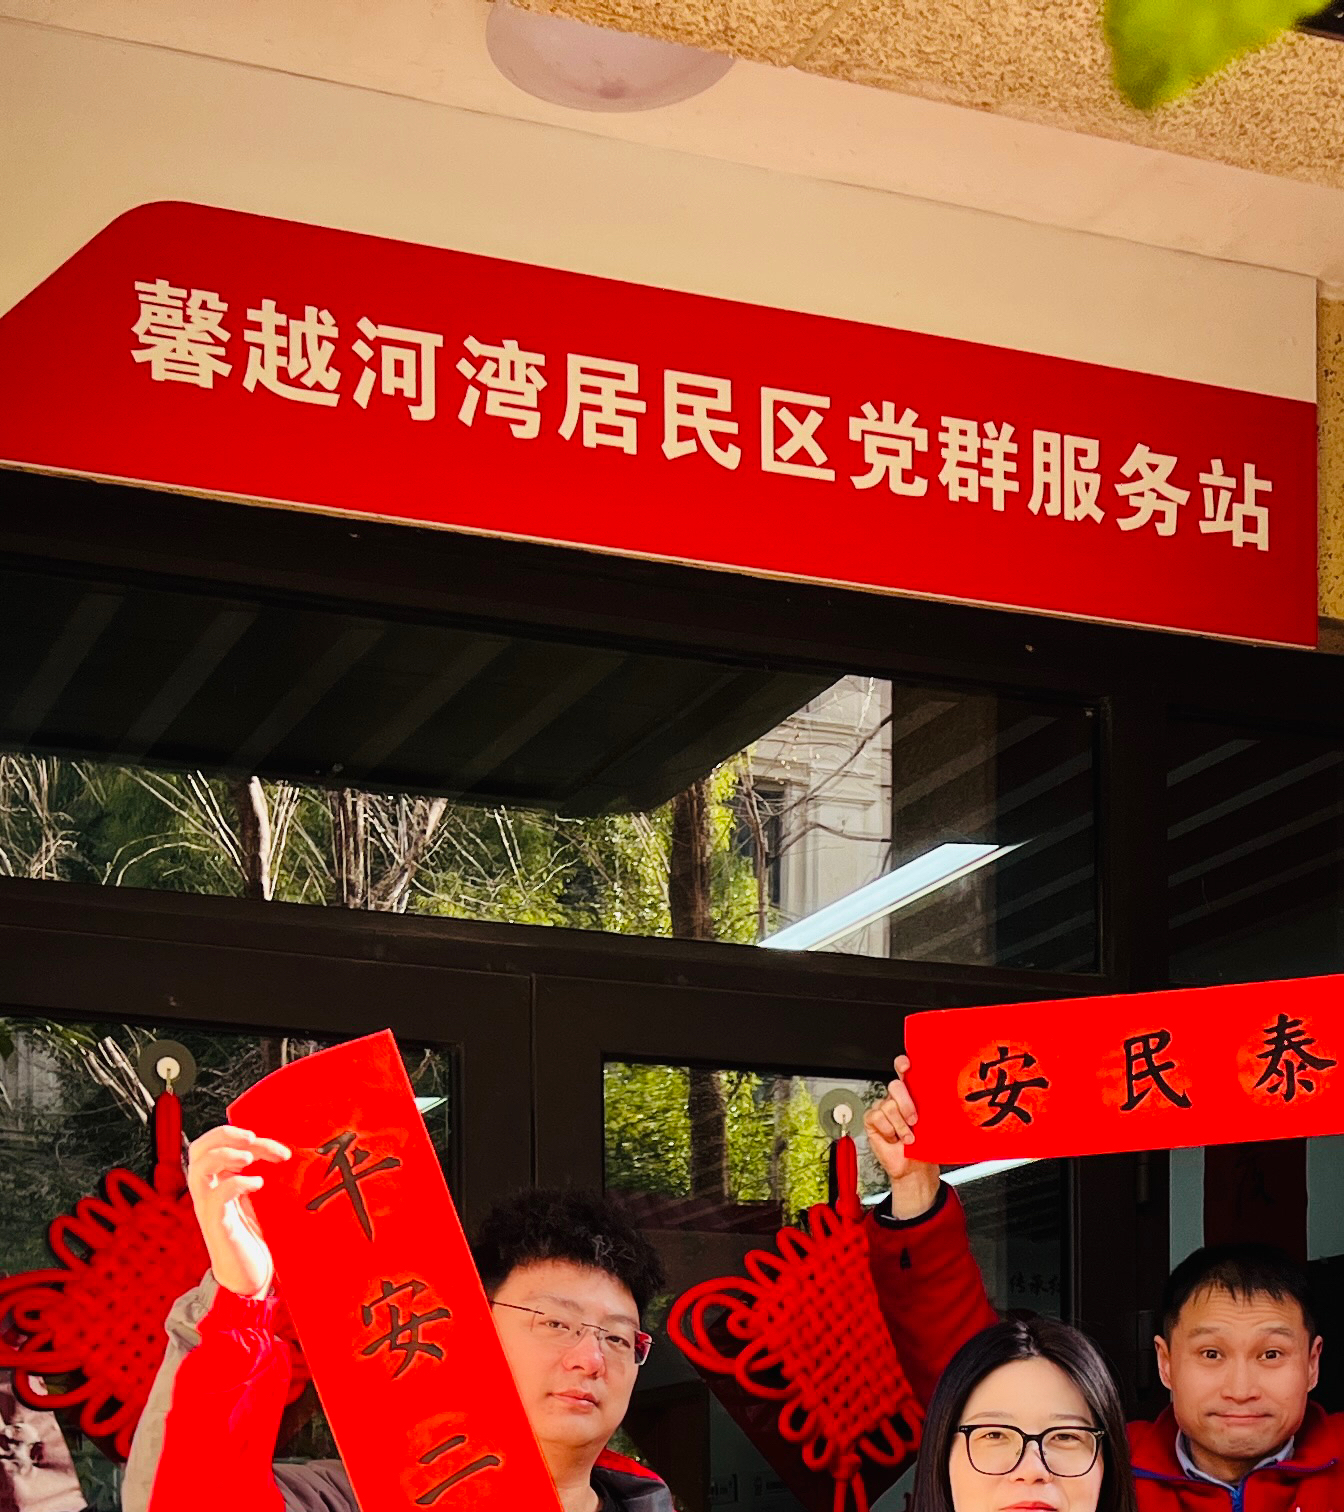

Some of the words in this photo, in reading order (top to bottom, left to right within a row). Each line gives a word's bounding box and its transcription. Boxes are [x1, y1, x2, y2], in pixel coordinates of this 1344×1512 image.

[130, 277, 1275, 553] 馨越河湾居民区党群服务站
